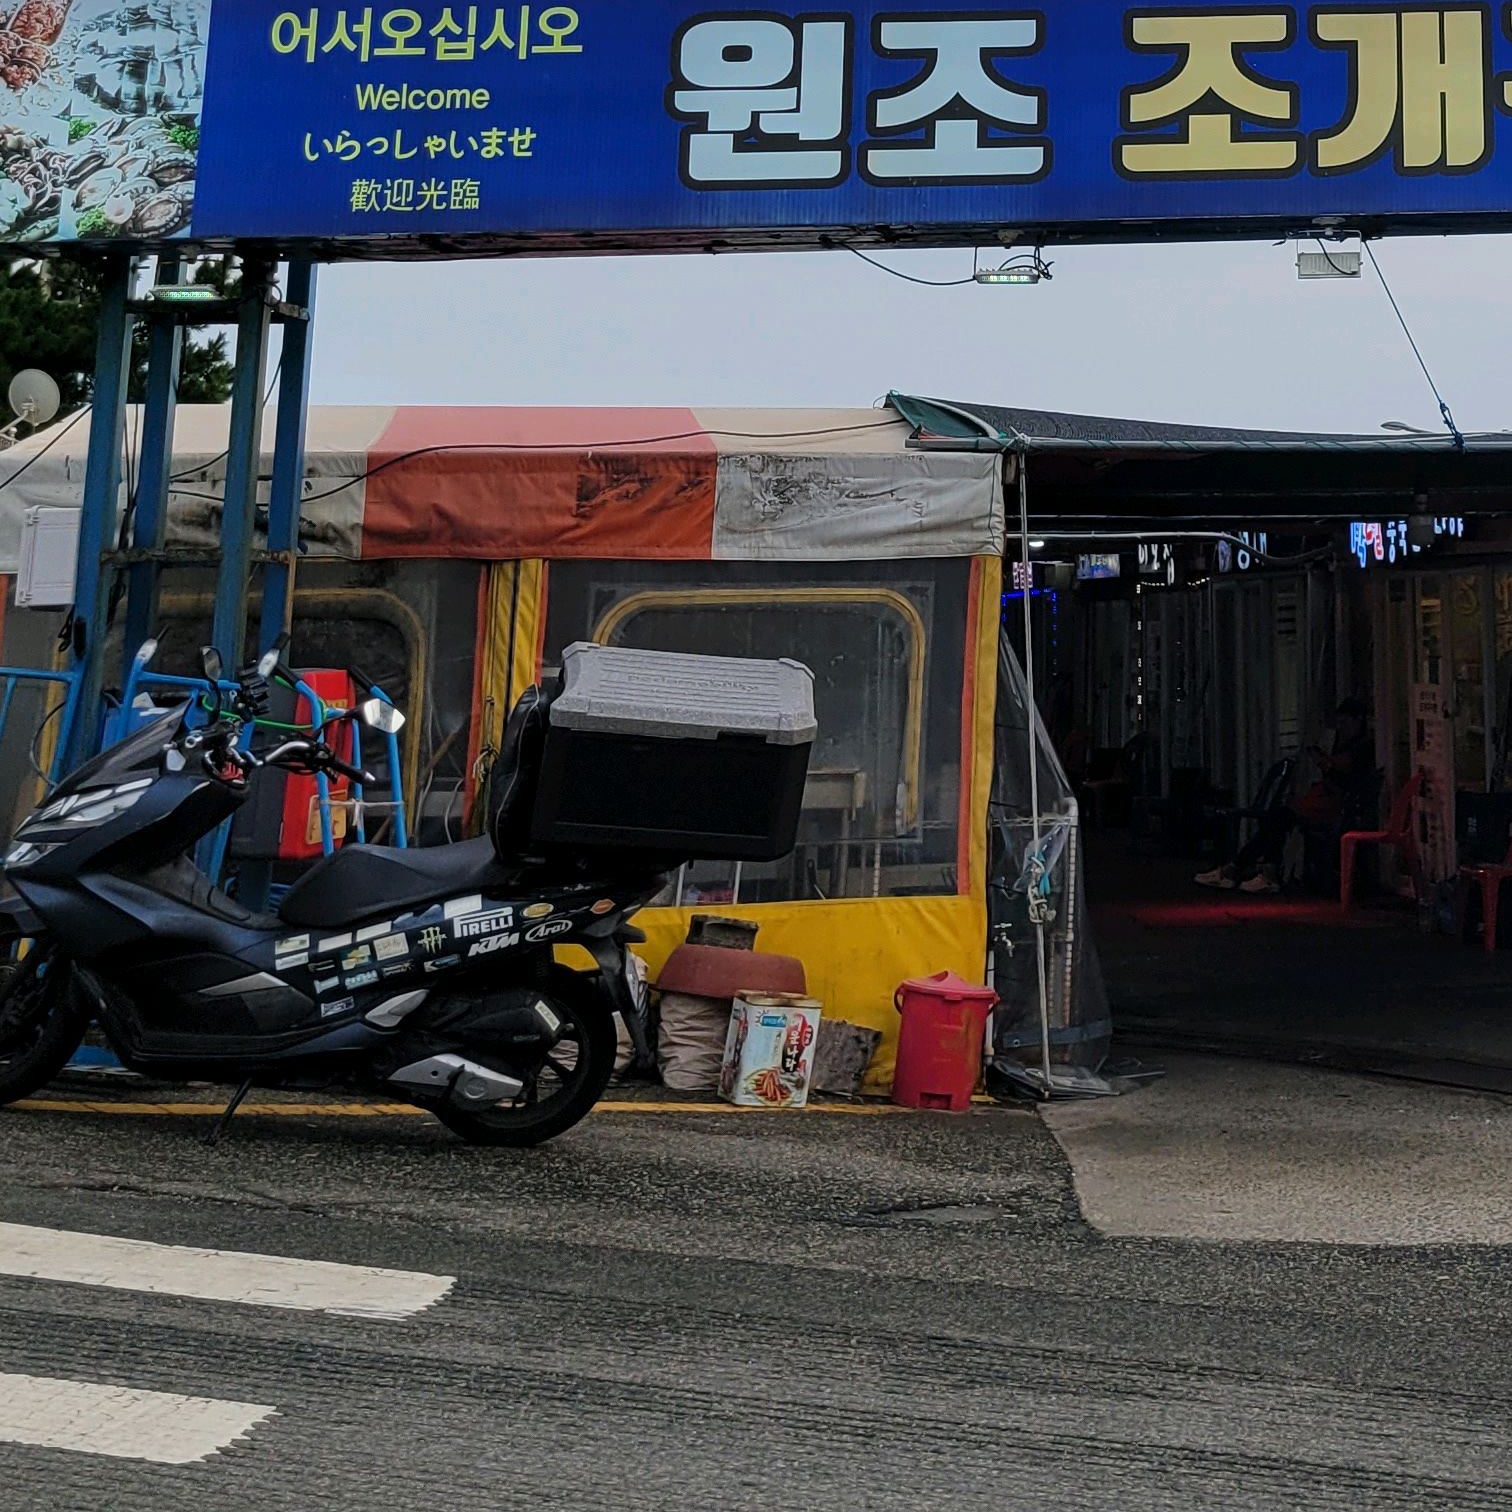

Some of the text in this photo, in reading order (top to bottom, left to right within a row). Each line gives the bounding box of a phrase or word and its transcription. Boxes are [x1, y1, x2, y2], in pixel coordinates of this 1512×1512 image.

[271, 5, 583, 64] 어서오십시오
[355, 83, 490, 112] Welcome
[672, 8, 1050, 189] 원조
[303, 125, 537, 161] いらっしゃいませ
[349, 178, 481, 213] 歡迎光臨
[453, 906, 514, 939] PIRELLI
[468, 931, 519, 957] KTM
